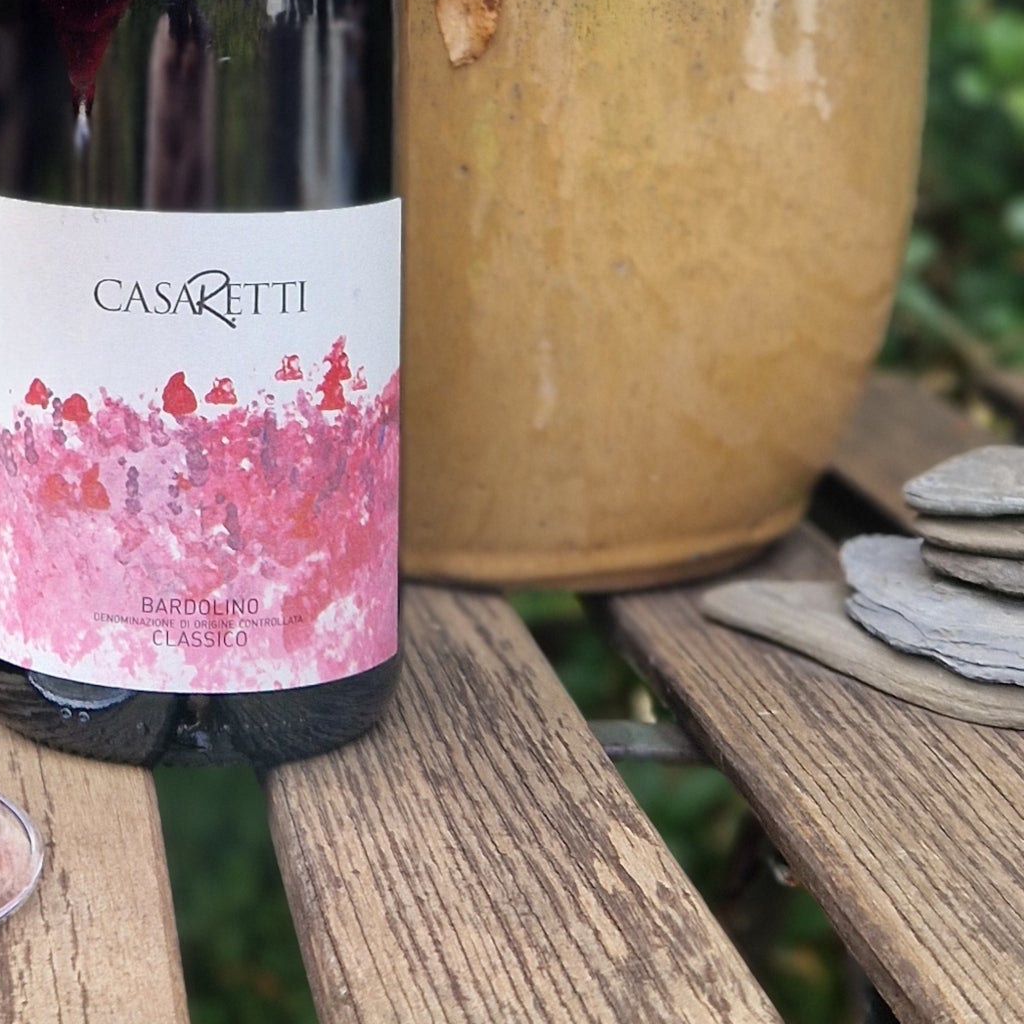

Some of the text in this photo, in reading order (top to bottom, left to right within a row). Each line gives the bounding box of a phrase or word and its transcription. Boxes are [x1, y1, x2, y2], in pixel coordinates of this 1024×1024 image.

[93, 269, 307, 329] CASARETTI
[141, 596, 259, 616] BARDOLINO
[93, 611, 304, 630] DENOMINAZIONE DI ORIGINE CONTROLLATA
[151, 629, 248, 648] CLASSICO
